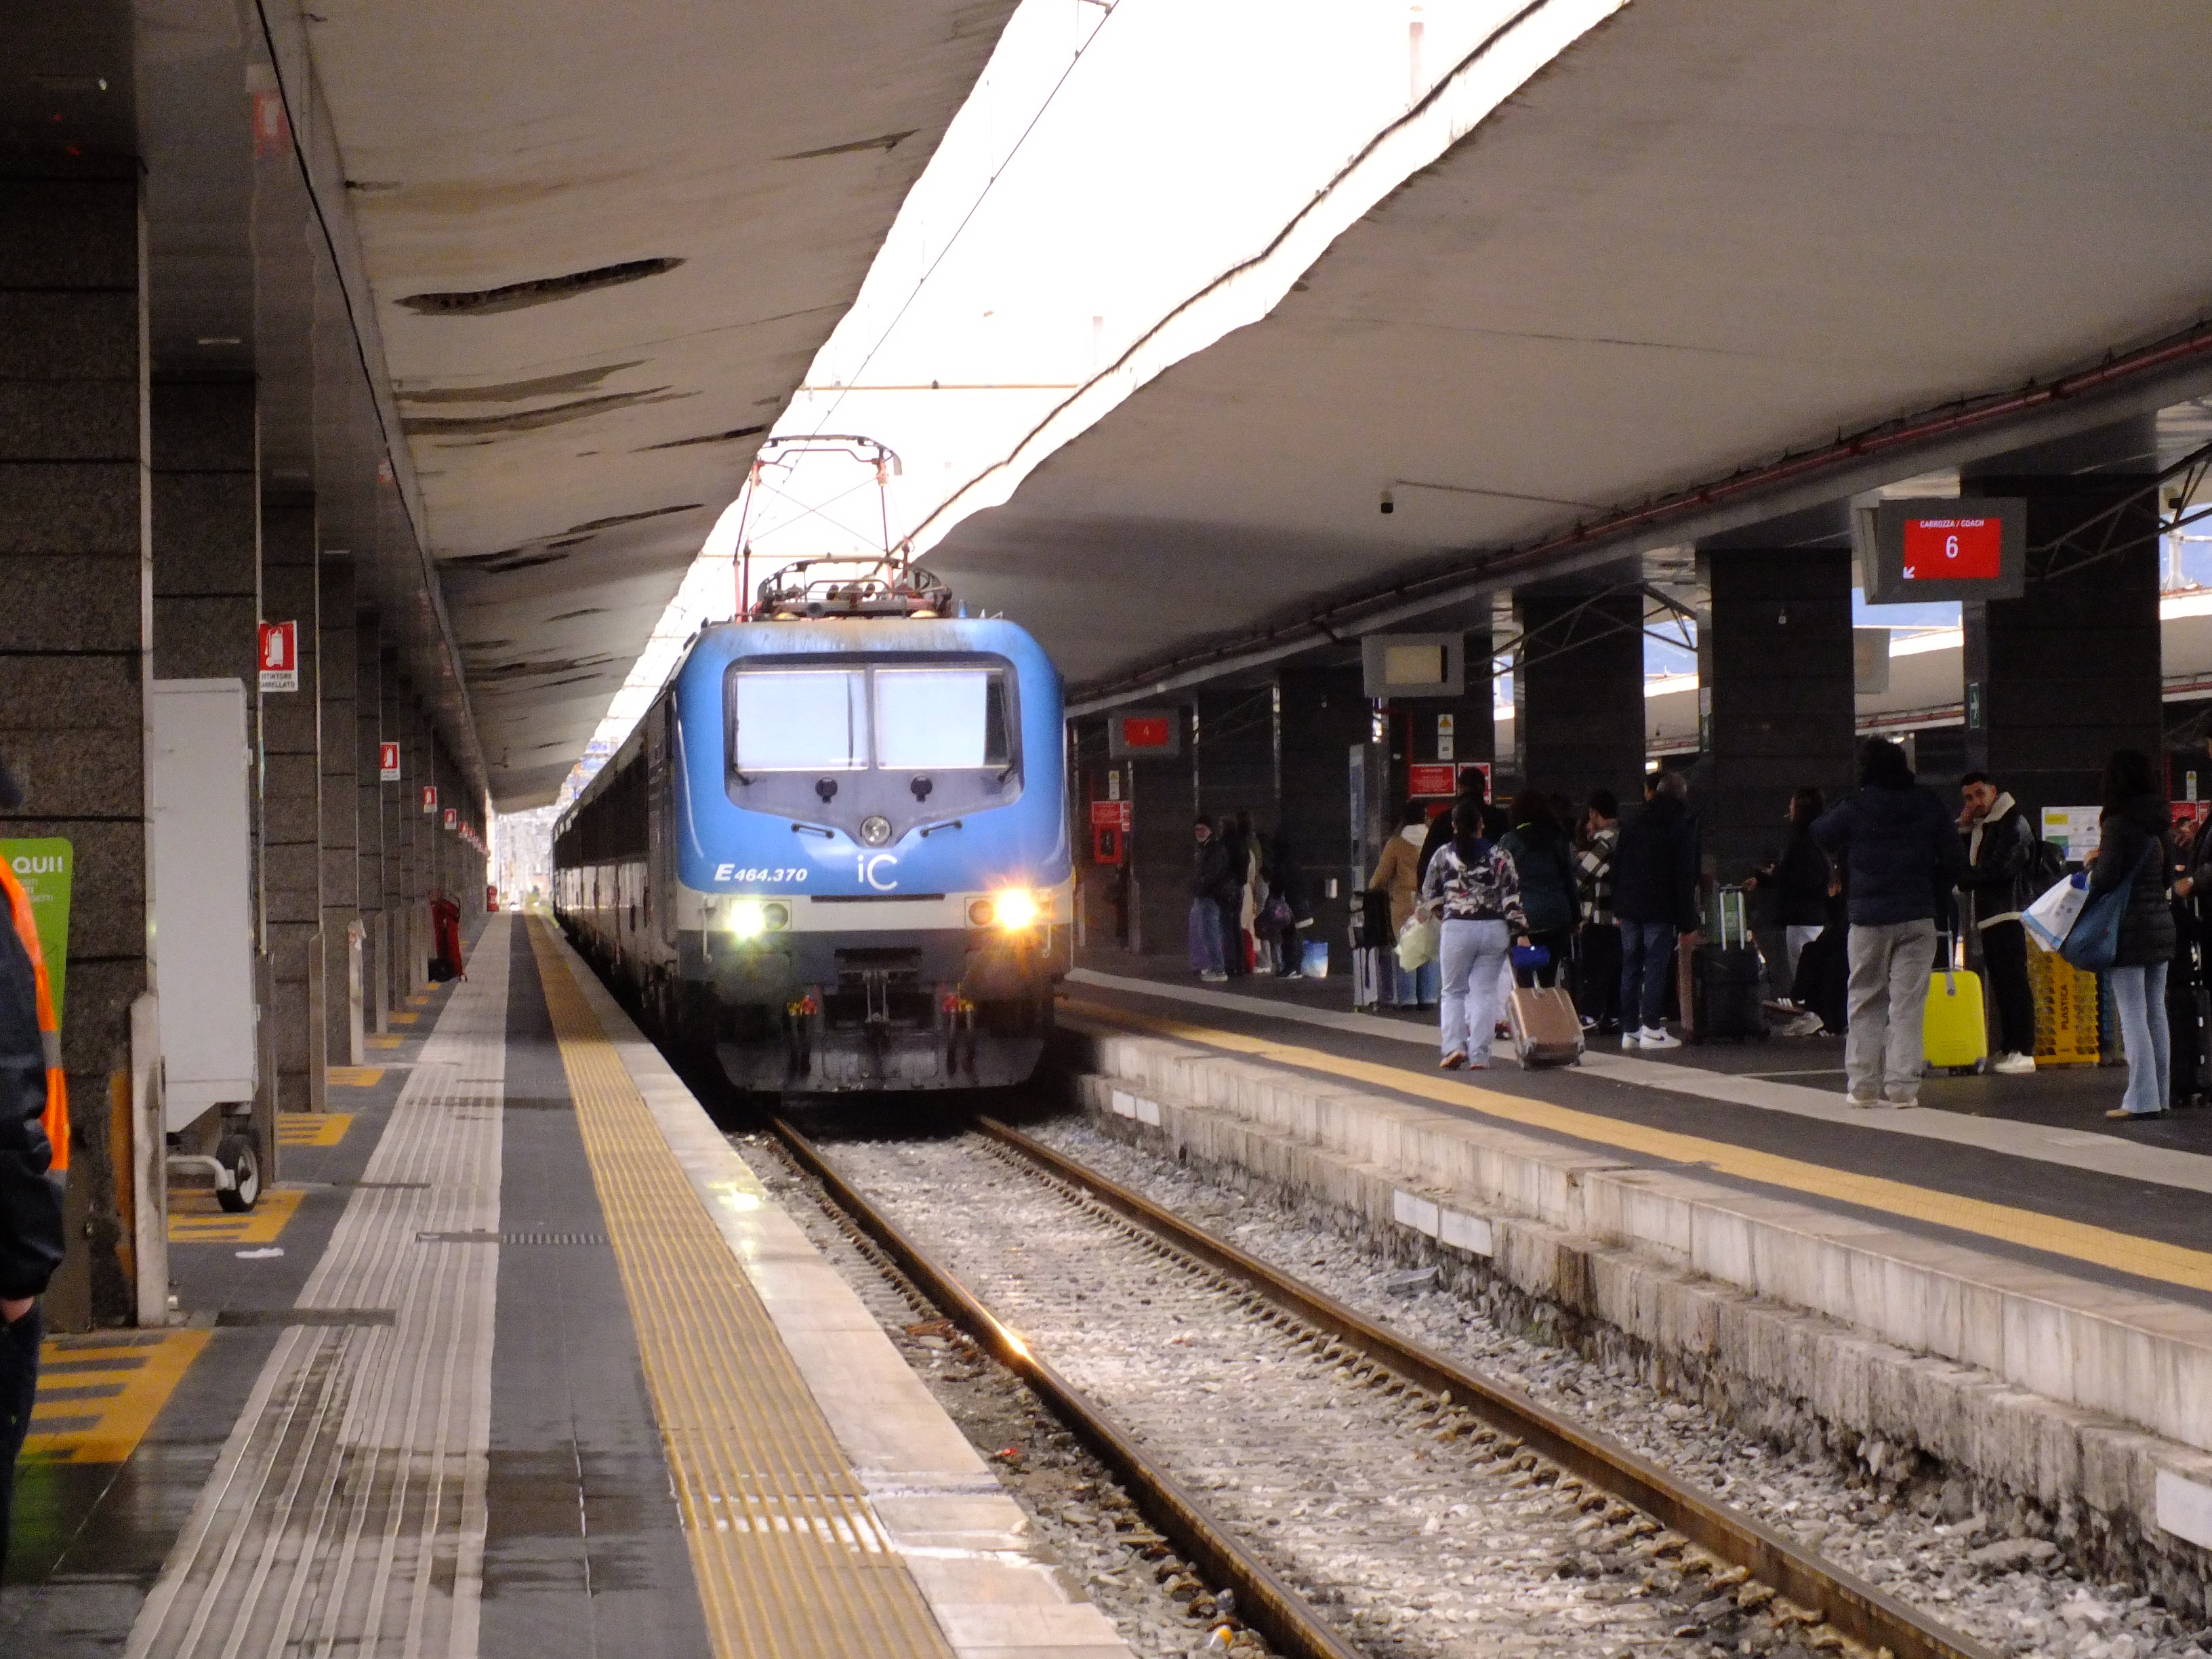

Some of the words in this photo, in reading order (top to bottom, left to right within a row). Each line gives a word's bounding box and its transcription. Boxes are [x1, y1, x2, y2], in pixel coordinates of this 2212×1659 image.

[1920, 520, 1954, 528] CARROZZA
[1961, 519, 1984, 527] COACH
[1946, 535, 1959, 558] 6
[12, 856, 64, 874] QUI!
[2060, 984, 2069, 1030] PLASTICA
